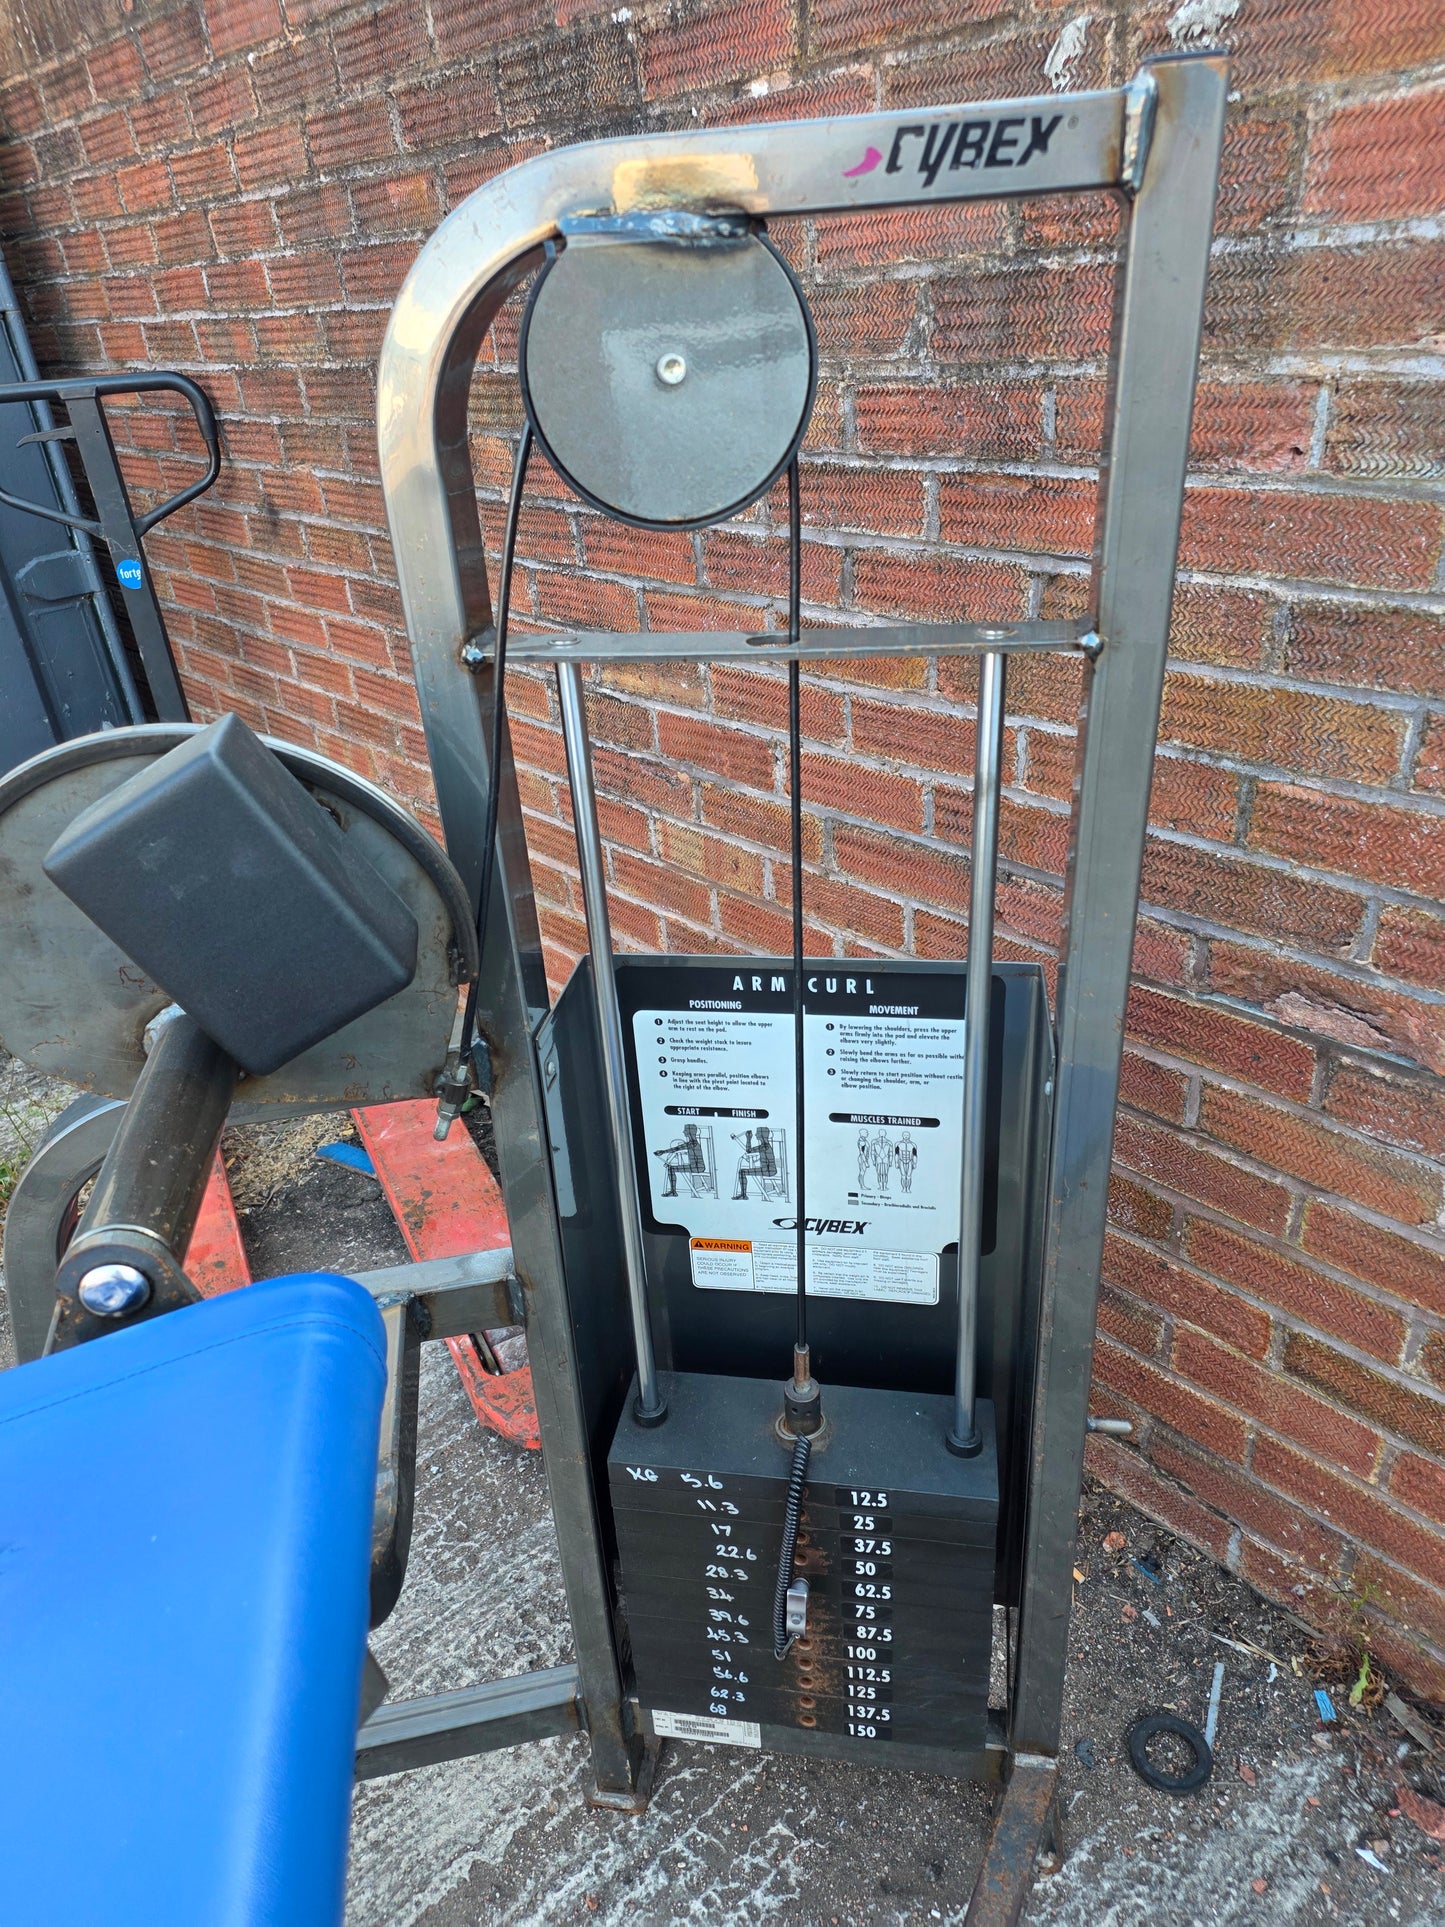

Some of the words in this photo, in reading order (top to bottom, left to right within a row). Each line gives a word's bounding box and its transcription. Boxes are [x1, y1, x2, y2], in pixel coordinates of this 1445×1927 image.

[886, 115, 1063, 188] CYBEX
[733, 976, 786, 991] ARM
[808, 978, 874, 994] CURL
[689, 1000, 742, 1009] POSITIONING
[869, 1005, 919, 1015] MOVEMENT
[851, 1115, 885, 1123] MUSCLES
[888, 1117, 921, 1125] TRAINED
[805, 1218, 868, 1235] CYBEX
[705, 1242, 749, 1250] WARNING
[626, 1467, 658, 1482] KG
[681, 1473, 723, 1489] 5.6
[851, 1491, 887, 1507] 12.5
[697, 1500, 739, 1514] 11.3
[711, 1524, 731, 1536] 17
[853, 1515, 874, 1530] 25
[716, 1544, 757, 1560] 22.6
[855, 1539, 891, 1555] 37.5
[705, 1564, 749, 1580] 28.3
[856, 1561, 875, 1576] 50
[706, 1587, 735, 1602] 34
[855, 1584, 891, 1599] 62.5
[708, 1609, 749, 1626] 39.6
[855, 1605, 875, 1619] 75
[707, 1626, 749, 1644] 45.3
[857, 1626, 892, 1641] 87.5
[712, 1649, 732, 1662] 51
[848, 1646, 876, 1660] 100
[713, 1666, 749, 1682] 56.6
[848, 1666, 891, 1682] 112.5
[710, 1686, 745, 1702] 62.3
[848, 1685, 876, 1699] 125
[710, 1702, 727, 1715] 68
[848, 1704, 890, 1721] 137.5
[849, 1724, 876, 1738] 150
